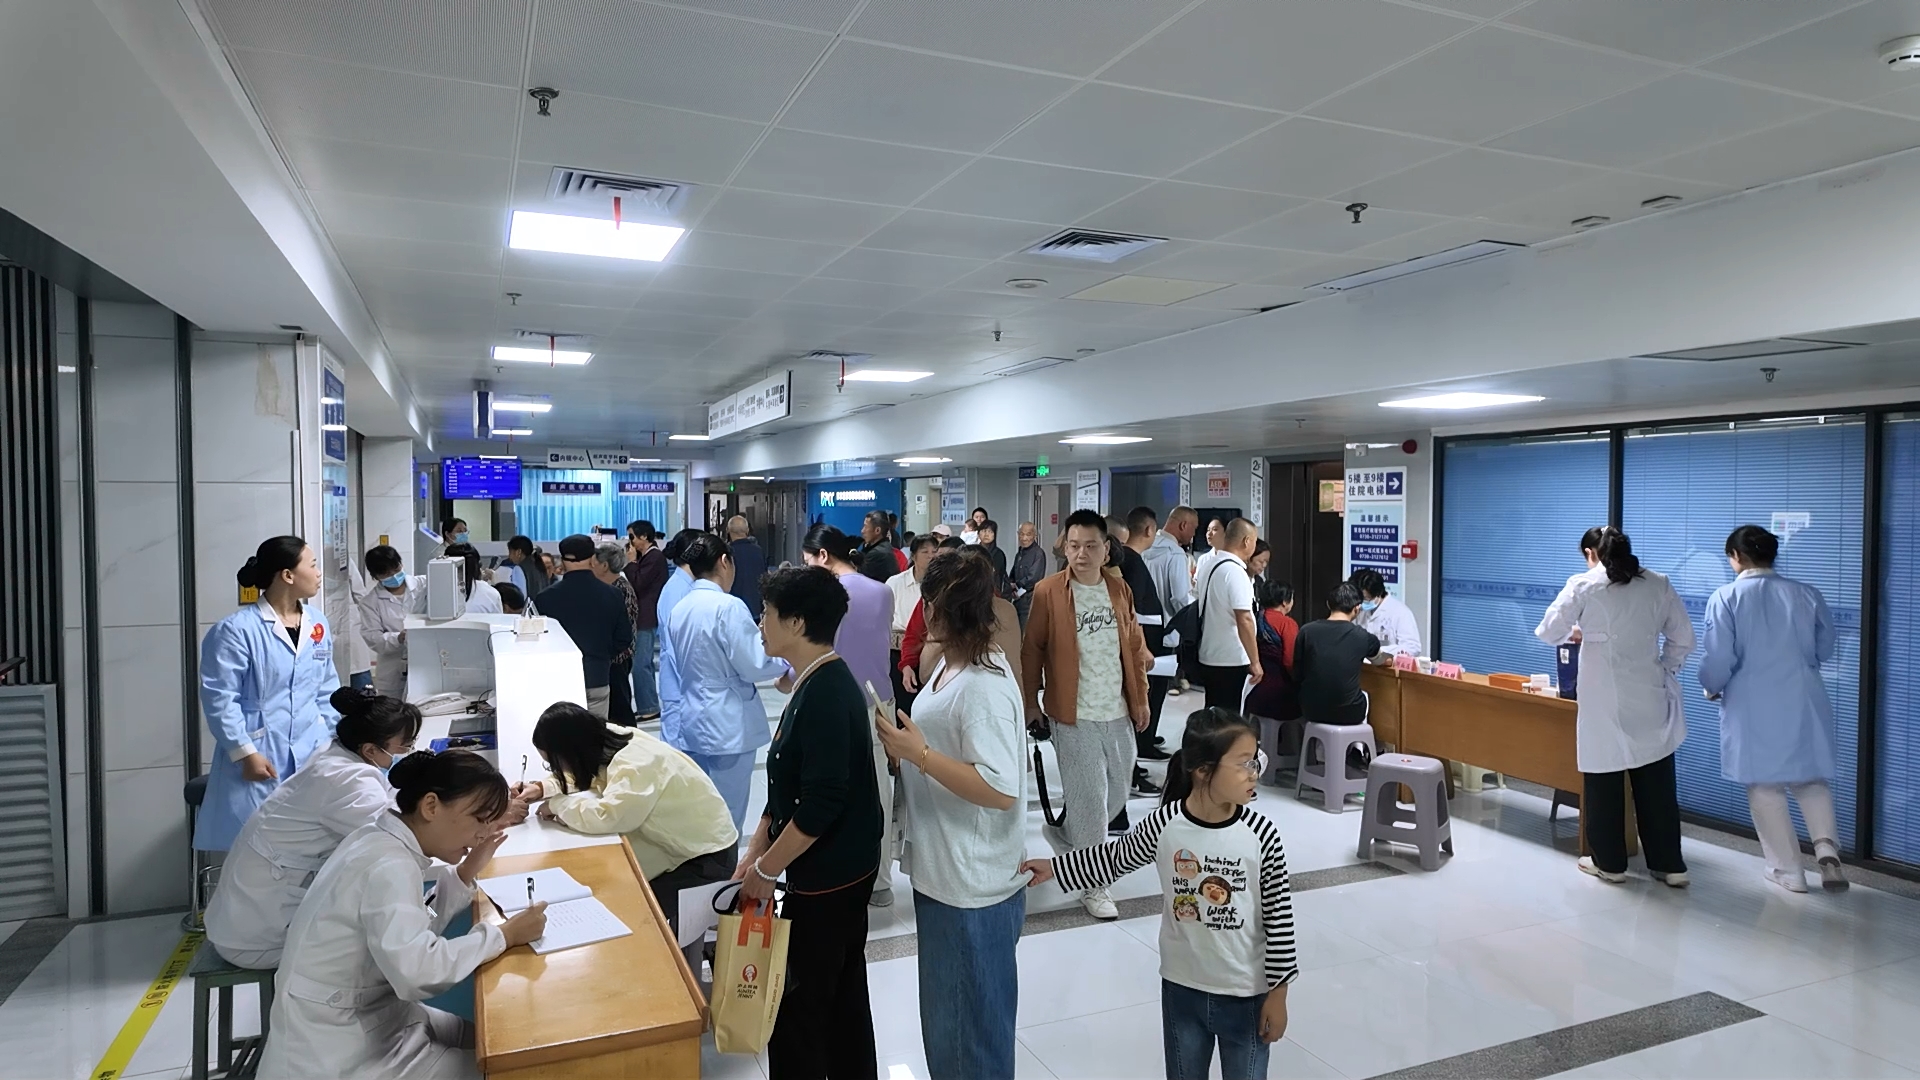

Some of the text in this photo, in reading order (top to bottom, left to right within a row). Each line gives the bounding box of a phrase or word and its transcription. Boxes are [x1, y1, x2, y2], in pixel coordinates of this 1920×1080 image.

[1348, 485, 1384, 496] 住院电梯
[1360, 514, 1389, 523] 温馨提示
[1204, 855, 1241, 867] behind
[1203, 864, 1220, 874] the
[1211, 915, 1236, 924] with
[1223, 919, 1245, 930] hand
